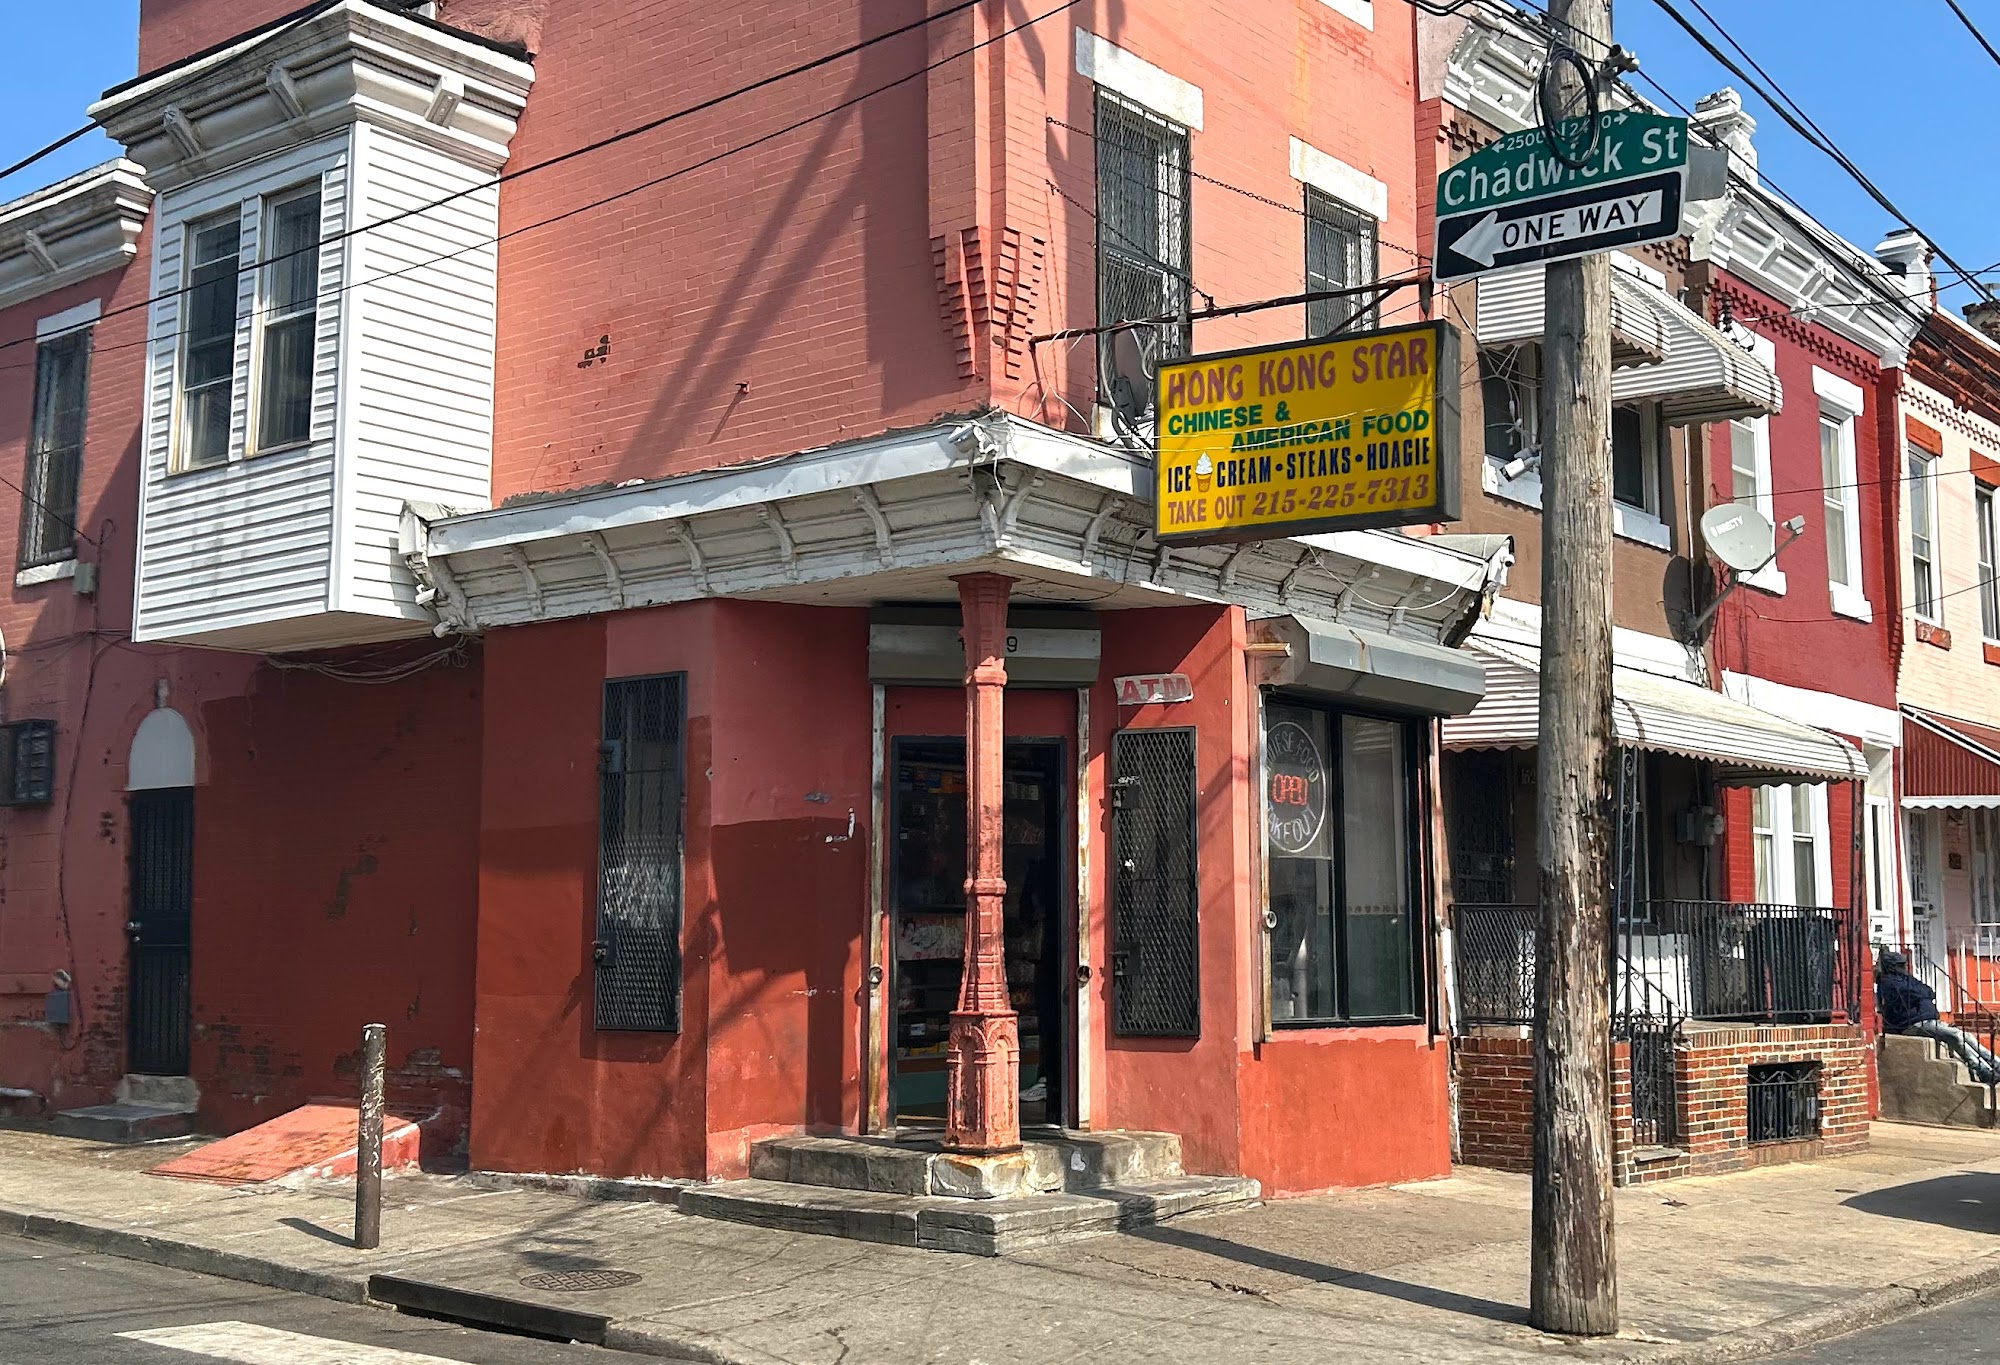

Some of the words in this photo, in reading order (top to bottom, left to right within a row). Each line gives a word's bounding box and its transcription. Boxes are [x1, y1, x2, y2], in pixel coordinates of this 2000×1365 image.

[1444, 135, 1623, 206] Chadwick
[1641, 126, 1679, 165] St
[1502, 213, 1565, 247] ONE
[1579, 196, 1649, 233] WAY
[1168, 364, 1243, 409] HONG
[1259, 351, 1335, 397] KONG
[1352, 338, 1428, 384] STAR
[1168, 404, 1262, 435] CHINESE
[1275, 401, 1290, 422] &
[1231, 419, 1350, 453] AMERICAN
[1362, 410, 1429, 437] FOOD
[1167, 465, 1191, 493] ICE
[1217, 456, 1272, 488] CREAM
[1286, 446, 1351, 480] STEAKS
[1367, 437, 1430, 471] HOAGIE
[1167, 499, 1207, 525] TAKE
[1214, 495, 1247, 520] OUT
[1251, 474, 1428, 516] 215-225-7313
[1121, 678, 1187, 700] ATM
[1272, 773, 1308, 805] OPEN
